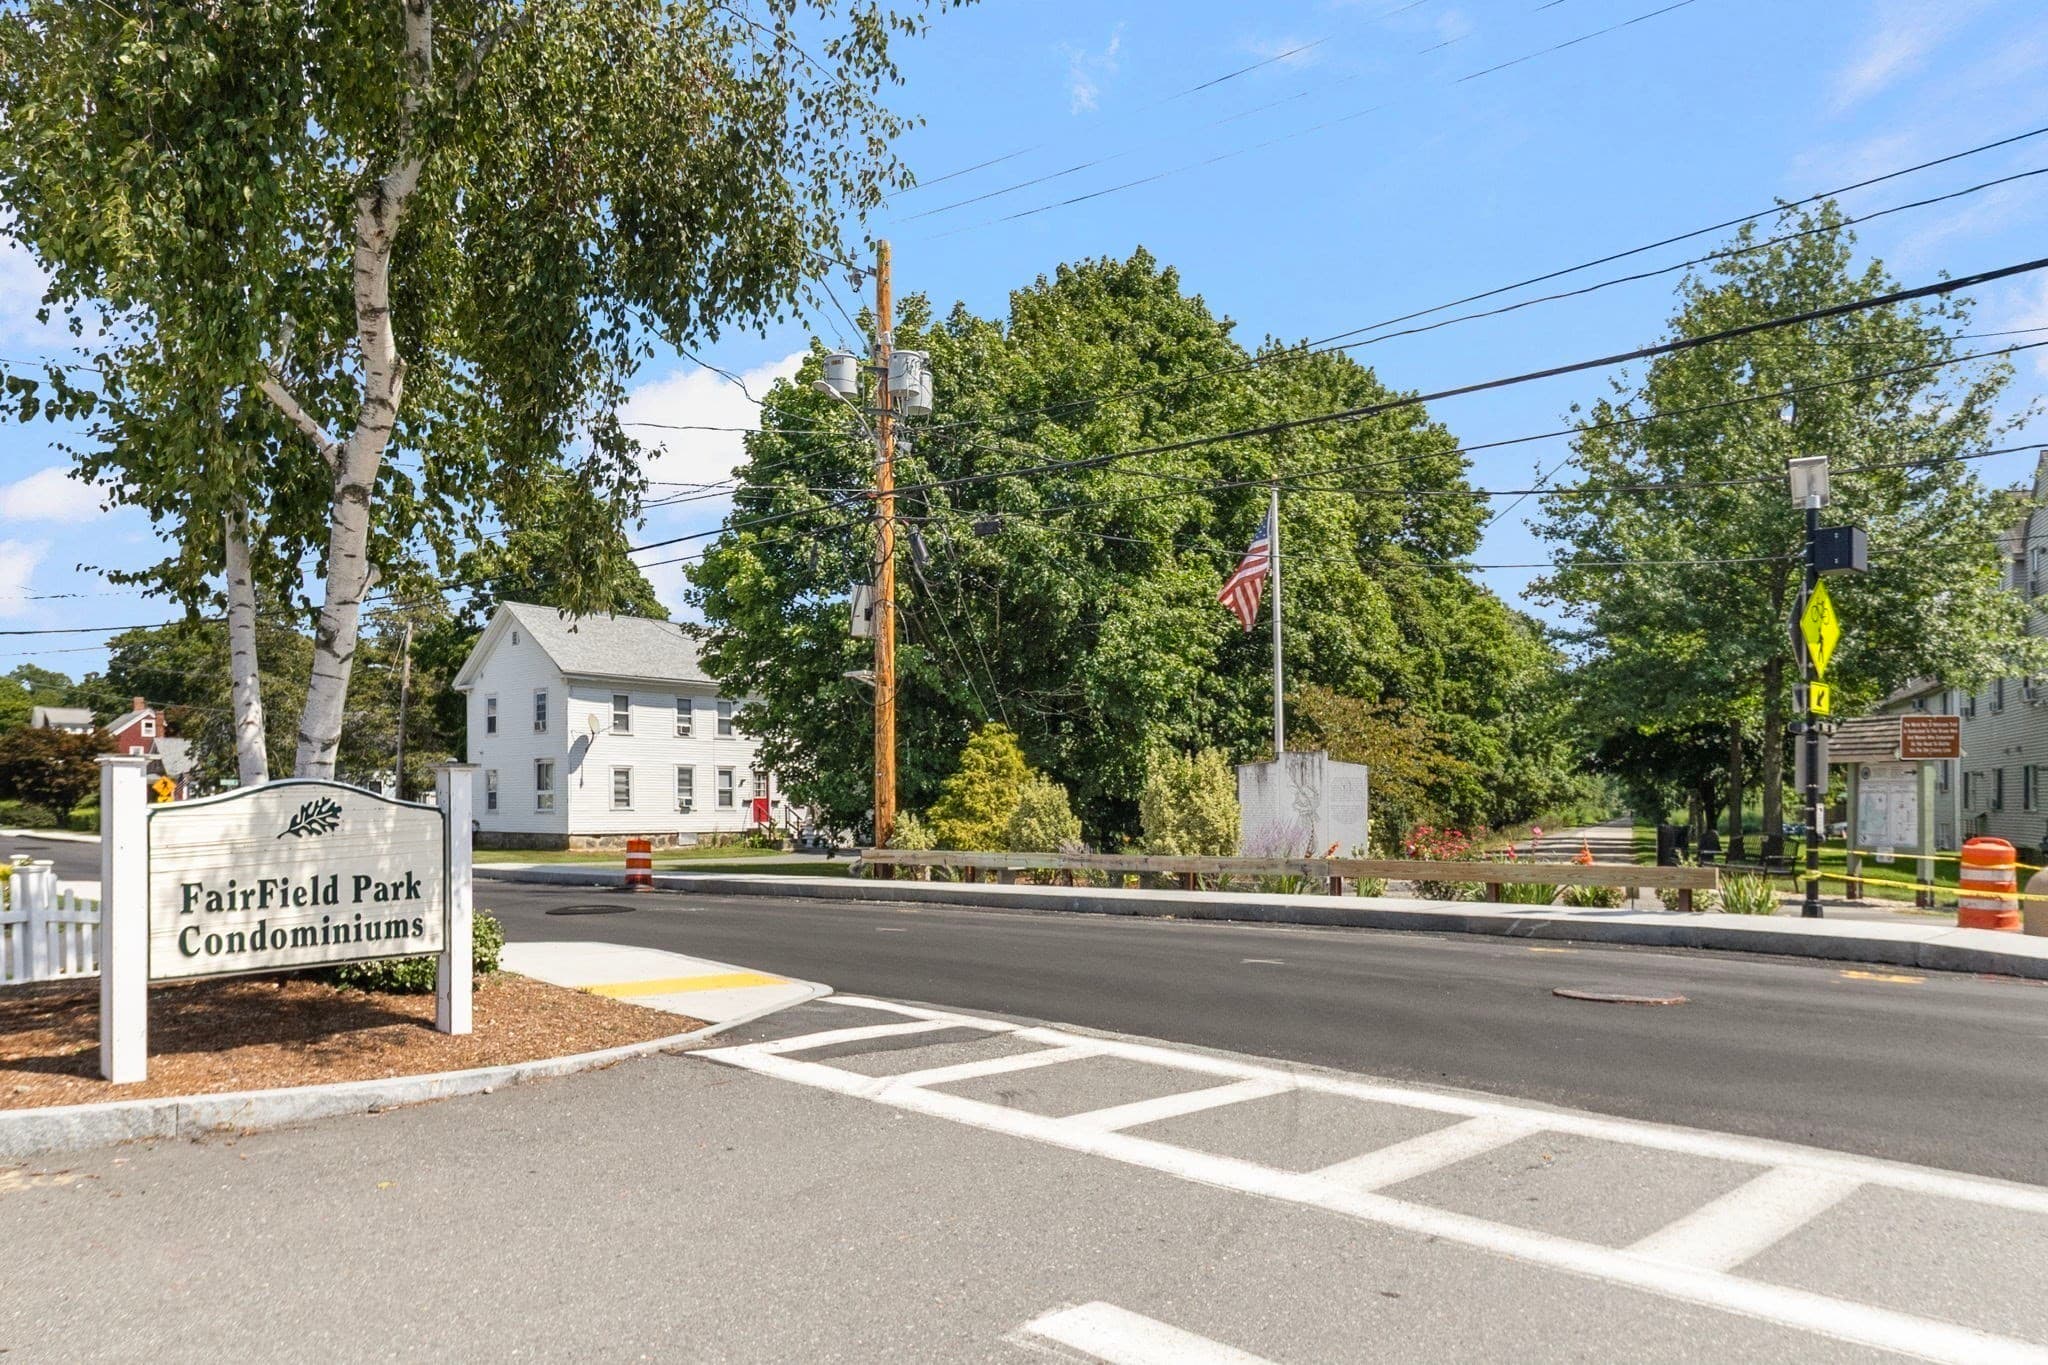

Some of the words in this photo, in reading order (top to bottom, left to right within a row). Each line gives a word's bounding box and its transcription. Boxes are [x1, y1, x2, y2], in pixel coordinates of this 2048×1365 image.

[180, 874, 339, 913] FairField
[352, 871, 422, 903] Park
[178, 913, 423, 957] Condominiums
